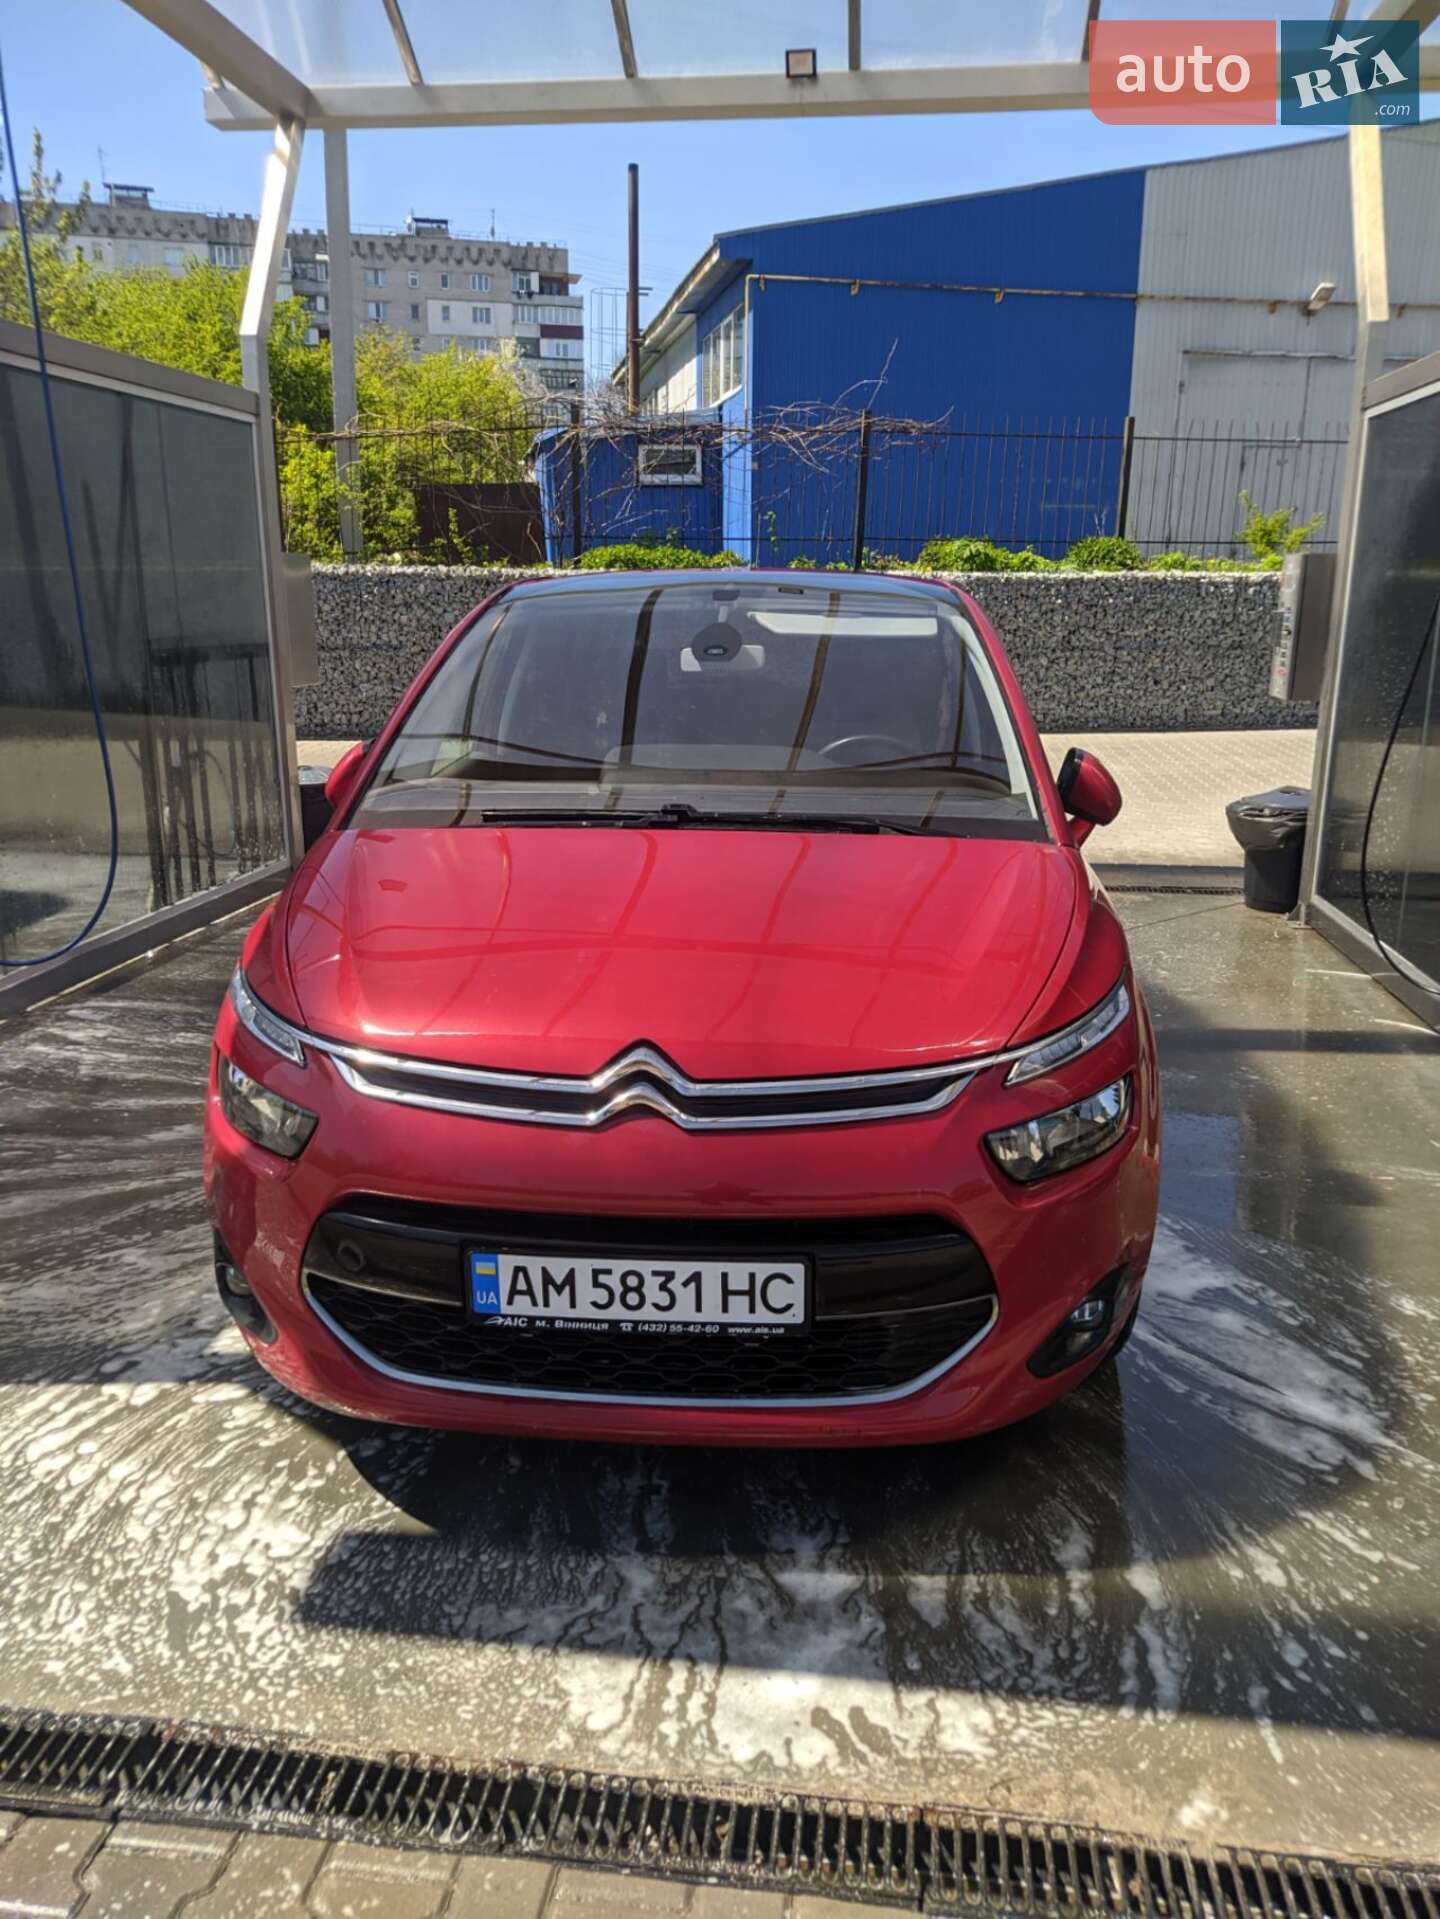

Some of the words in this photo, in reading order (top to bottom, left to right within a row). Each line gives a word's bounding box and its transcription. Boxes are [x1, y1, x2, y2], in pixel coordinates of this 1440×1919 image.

[477, 1290, 498, 1305] UA
[590, 1268, 703, 1313] 5831
[638, 1323, 667, 1333] (432)
[669, 1325, 720, 1333] 55-42-60
